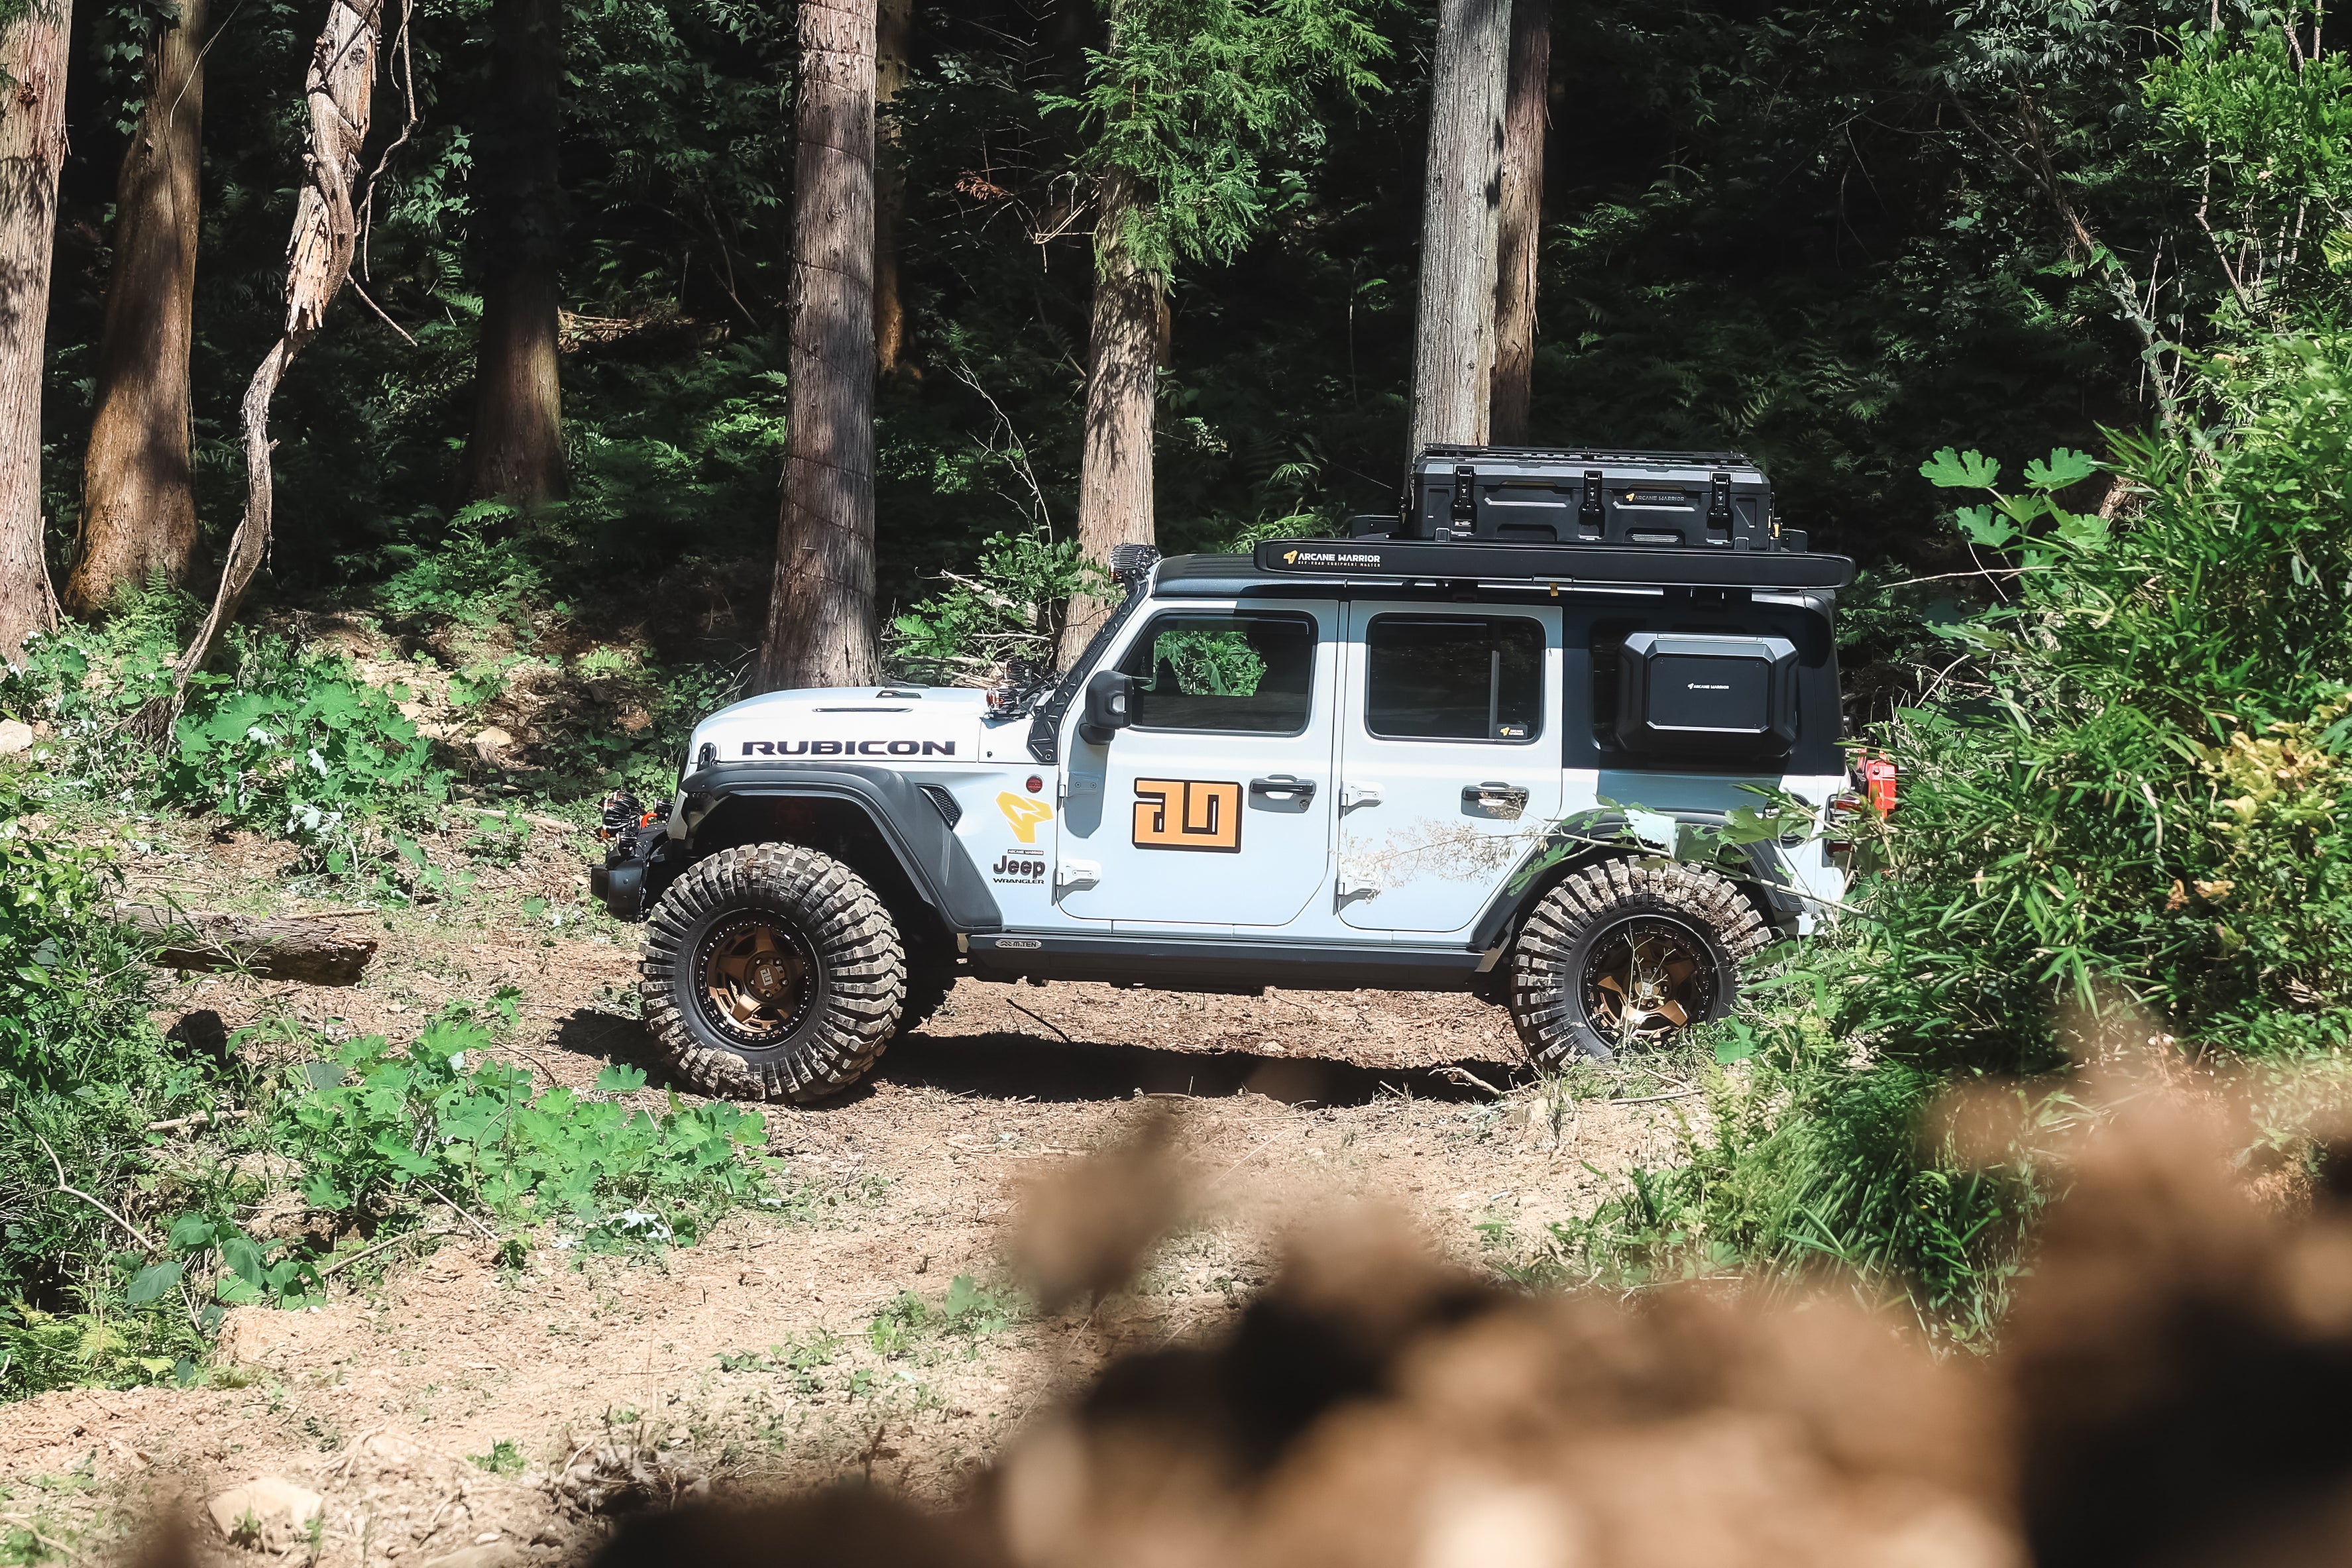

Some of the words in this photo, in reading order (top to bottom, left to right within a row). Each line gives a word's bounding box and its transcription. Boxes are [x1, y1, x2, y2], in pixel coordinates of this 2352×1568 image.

[1298, 553, 1335, 561] ARCANE
[1338, 554, 1380, 563] WARRIOR
[742, 741, 956, 756] RUBICON
[993, 855, 1046, 879] Jeep
